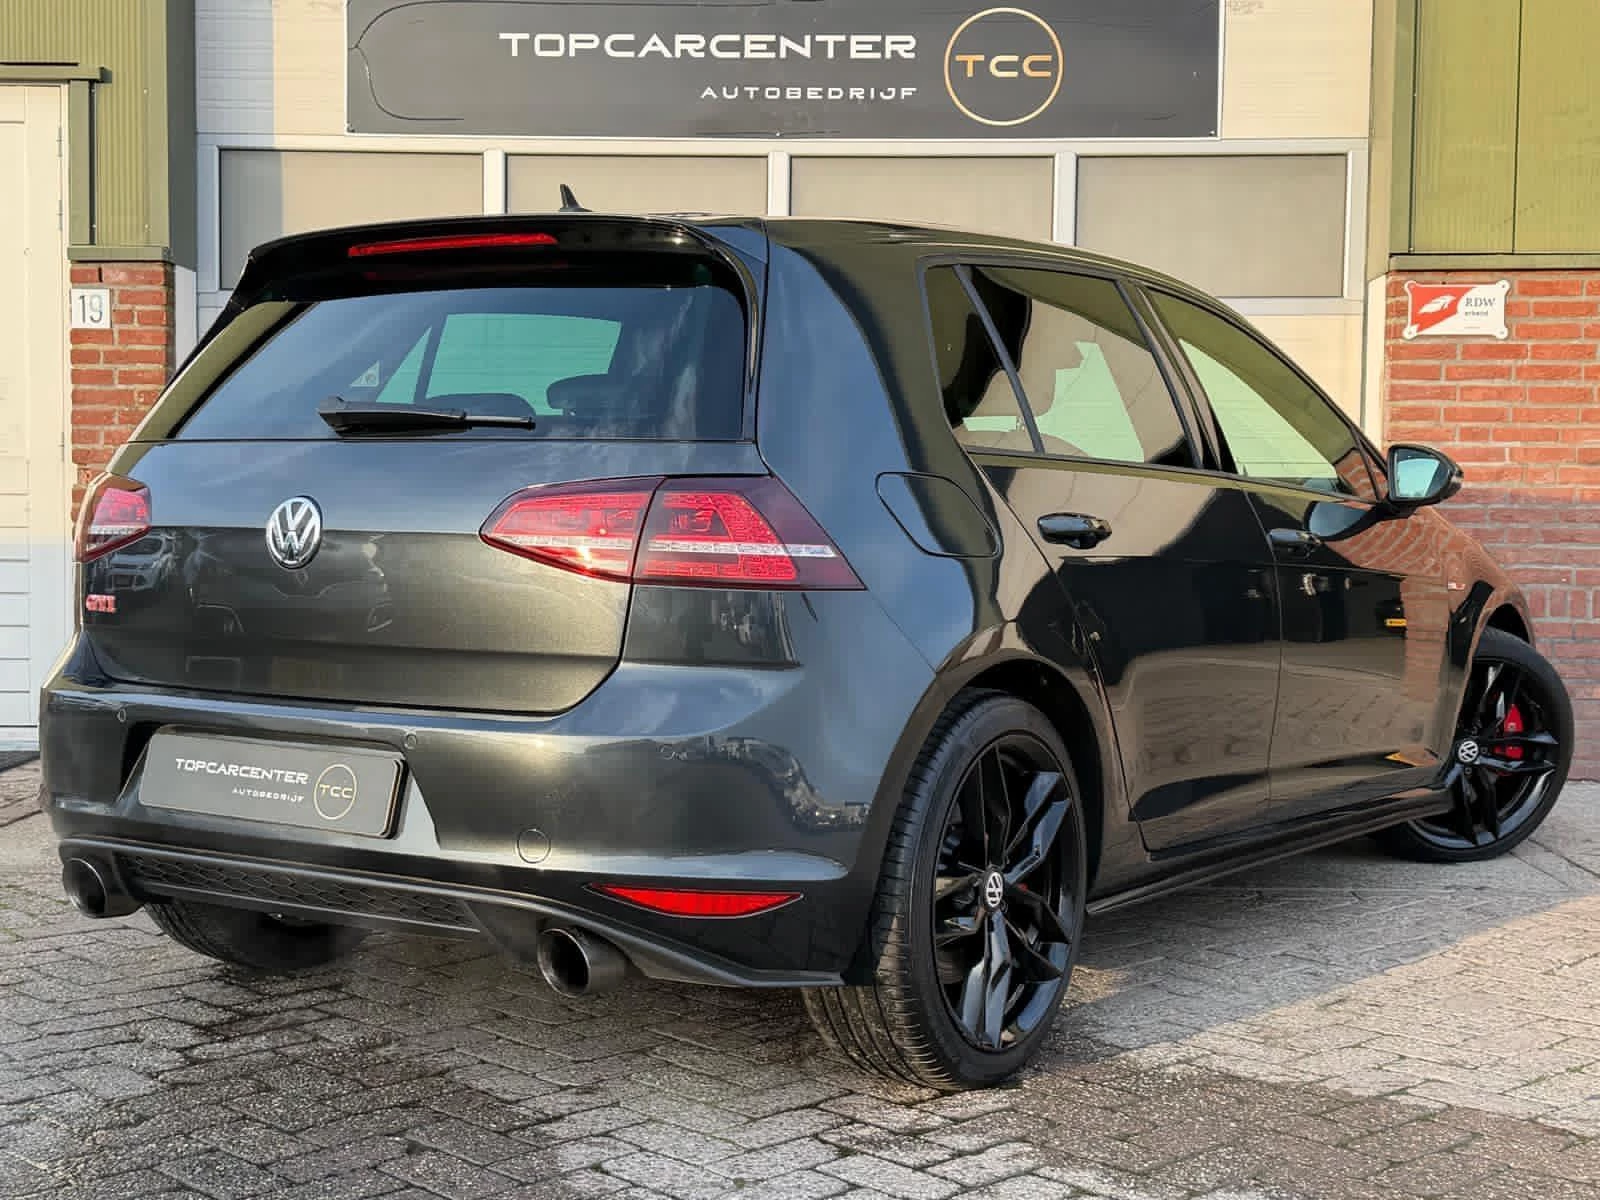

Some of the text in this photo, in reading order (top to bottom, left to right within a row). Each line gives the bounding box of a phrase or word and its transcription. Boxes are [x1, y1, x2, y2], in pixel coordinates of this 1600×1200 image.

[498, 32, 917, 60] TOPCARCENTER
[955, 54, 1052, 78] TCC
[700, 85, 917, 101] AUTOBEDRIJF
[78, 294, 103, 324] 19
[1465, 296, 1496, 307] RDW
[175, 757, 309, 785] TOPCARCENTER
[231, 786, 305, 803] AUTOBEDRIJF
[319, 783, 353, 799] TCC
